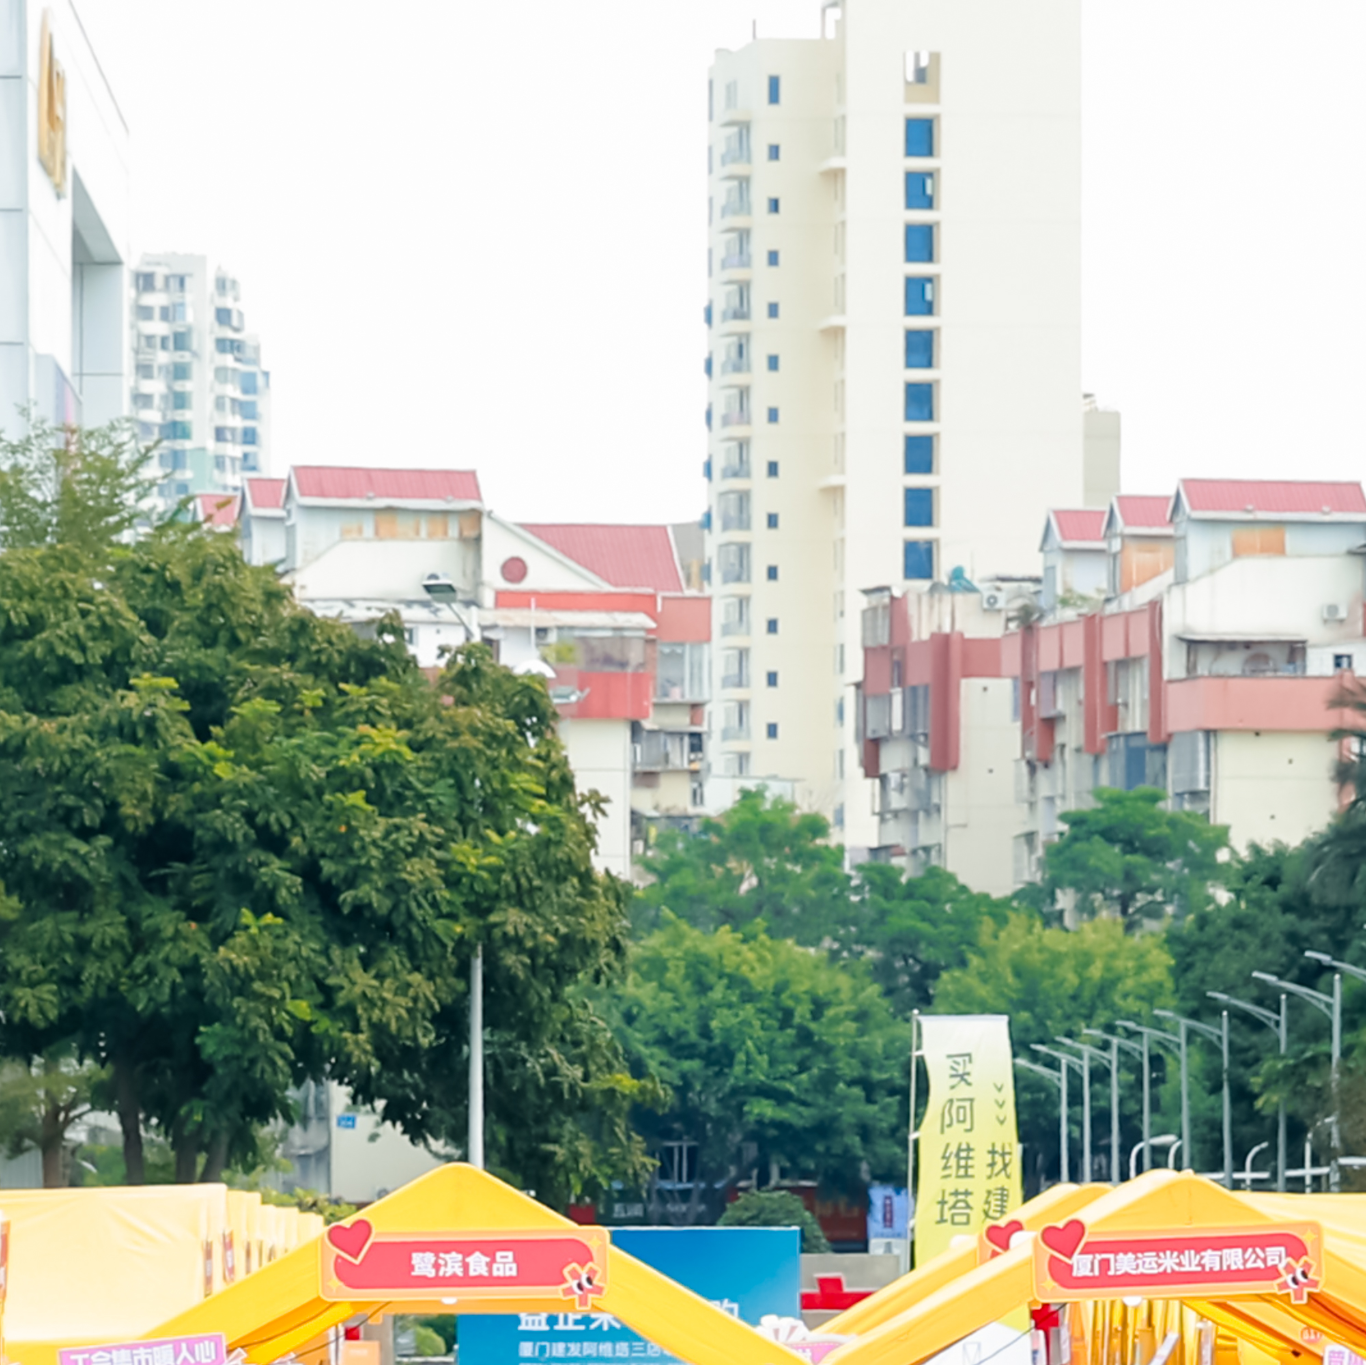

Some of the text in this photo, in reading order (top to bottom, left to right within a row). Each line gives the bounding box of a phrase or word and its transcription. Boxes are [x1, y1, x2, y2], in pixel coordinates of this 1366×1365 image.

[935, 1051, 977, 1227] 买阿维塔
[410, 1250, 519, 1279] 鹭滨食品
[1071, 1246, 1288, 1279] 厦门美运米业有限公司
[518, 1341, 669, 1358] 厦门建发阿维塔三店
